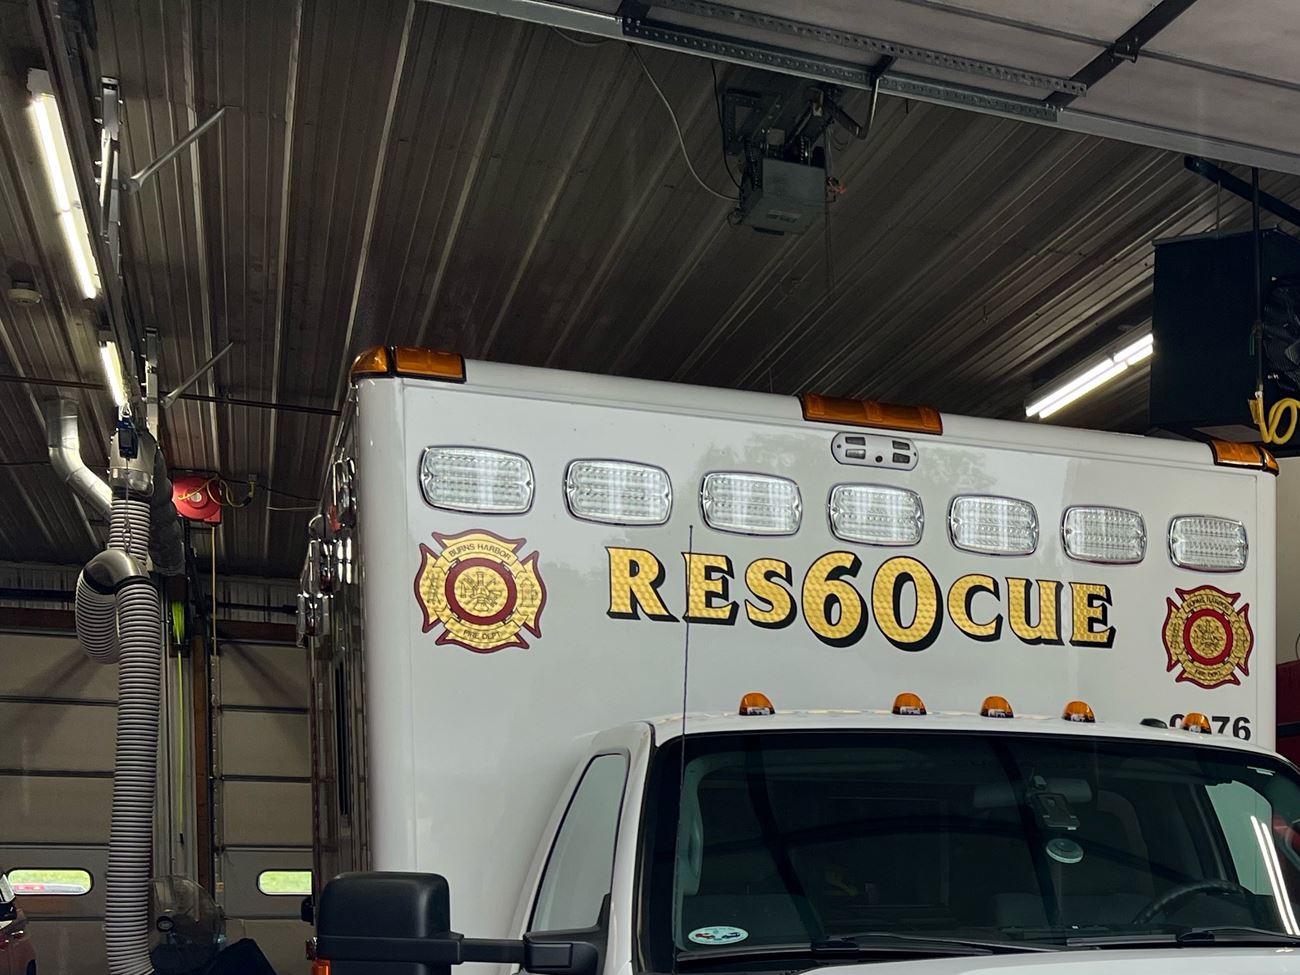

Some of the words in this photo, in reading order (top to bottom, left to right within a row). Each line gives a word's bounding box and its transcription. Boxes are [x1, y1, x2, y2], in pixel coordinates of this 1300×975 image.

[448, 543, 476, 557] BURNS
[477, 543, 512, 560] HARBOR
[606, 546, 1117, 652] RES60CUE
[462, 630, 480, 640] FIRE
[481, 631, 502, 640] DEPT
[1169, 713, 1251, 741] 76
